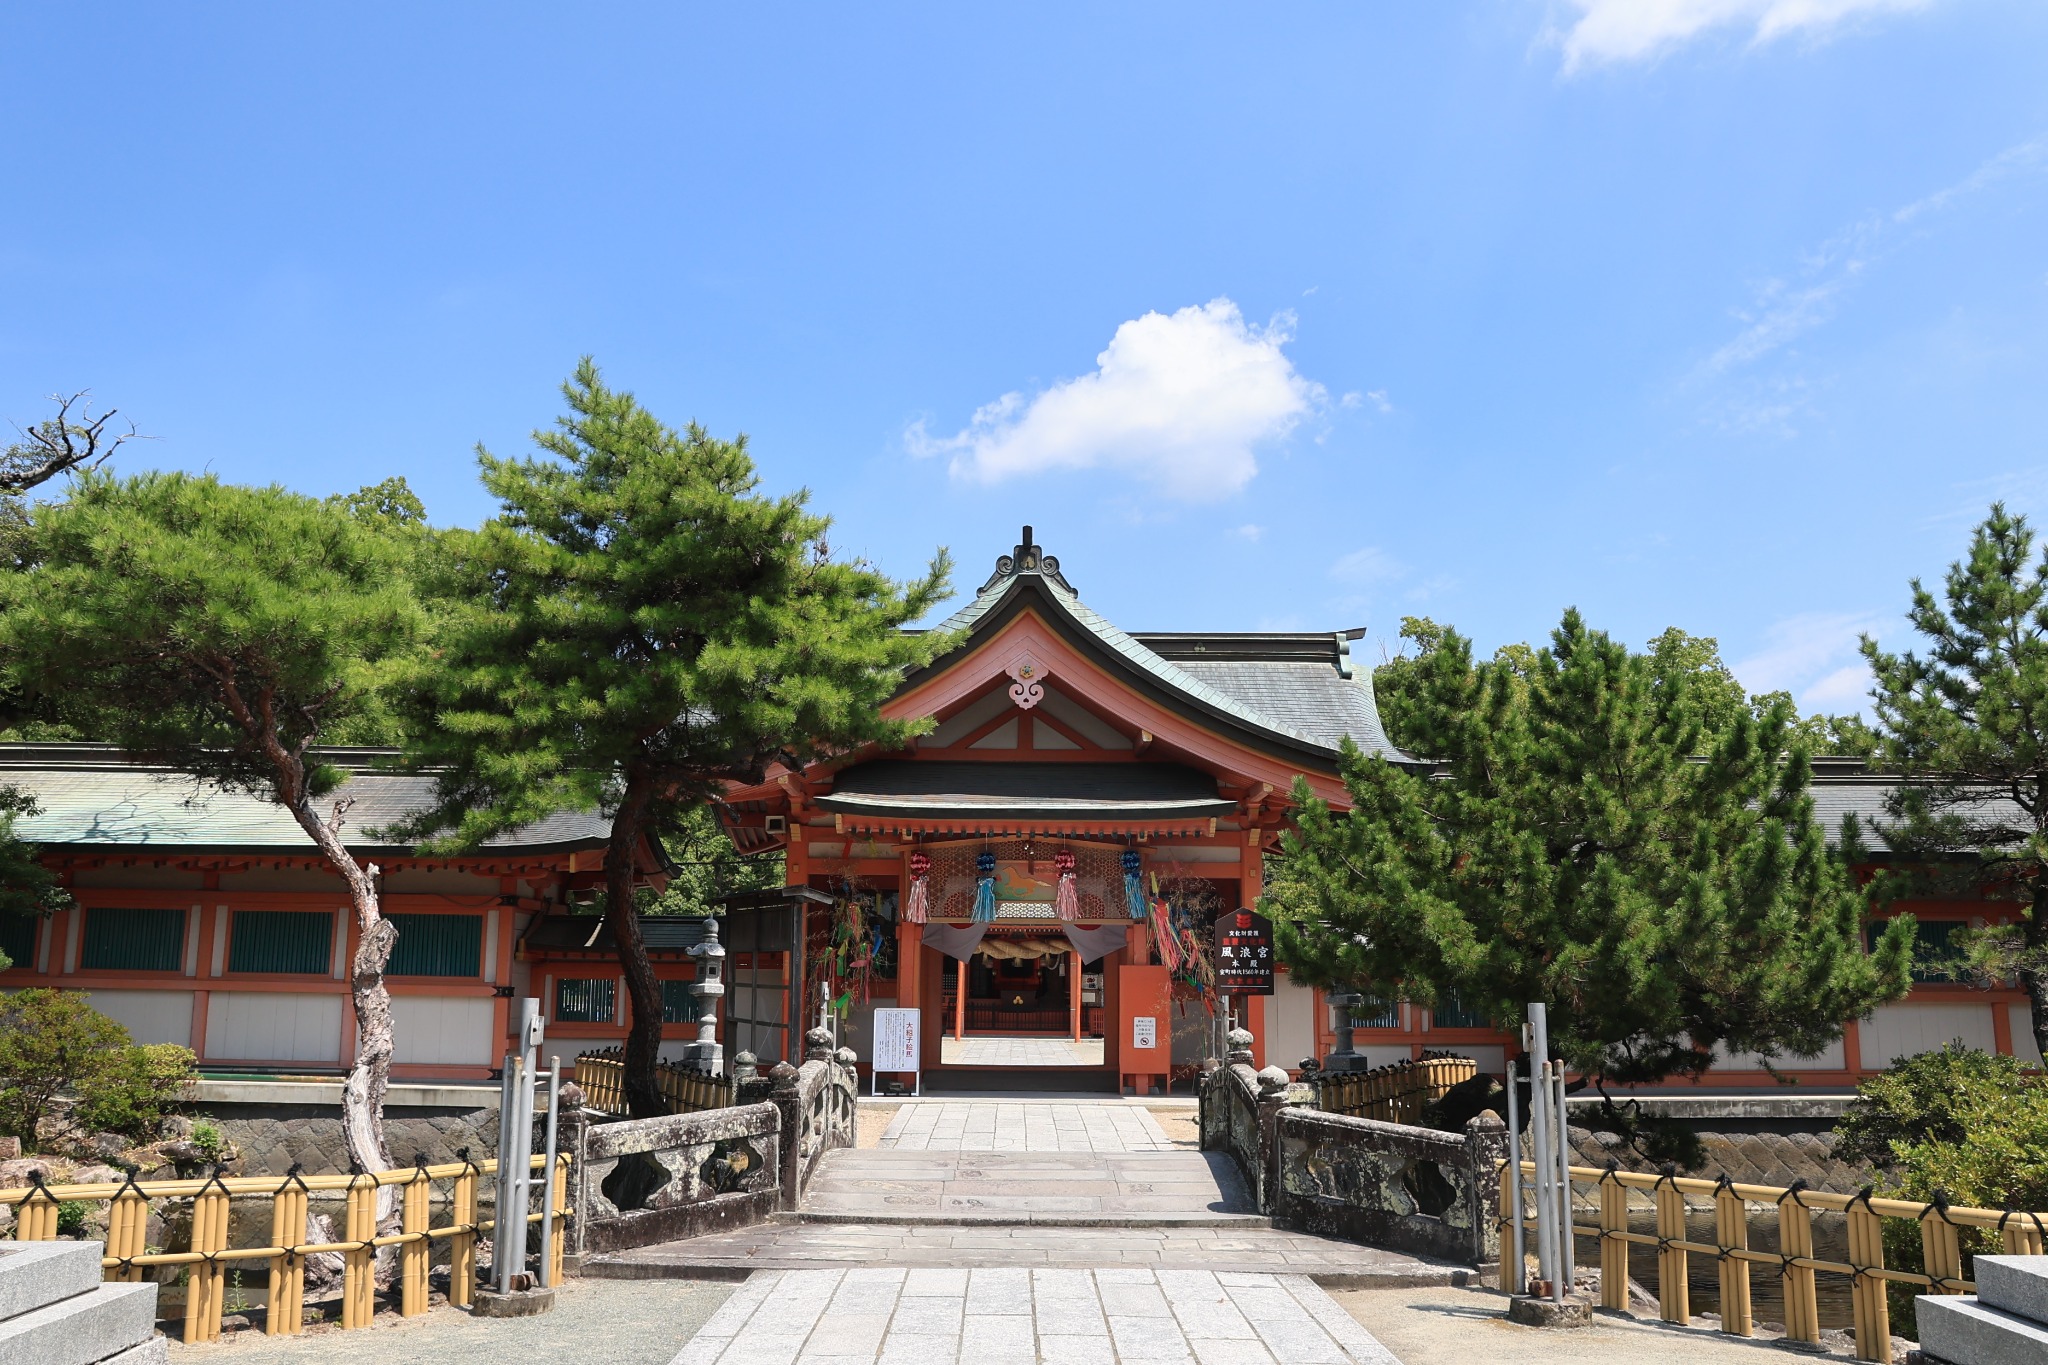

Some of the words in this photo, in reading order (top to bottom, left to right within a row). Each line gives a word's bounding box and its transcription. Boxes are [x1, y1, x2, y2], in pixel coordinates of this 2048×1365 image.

[1221, 946, 1269, 958] 風浪宮
[1232, 959, 1258, 968] 本殿
